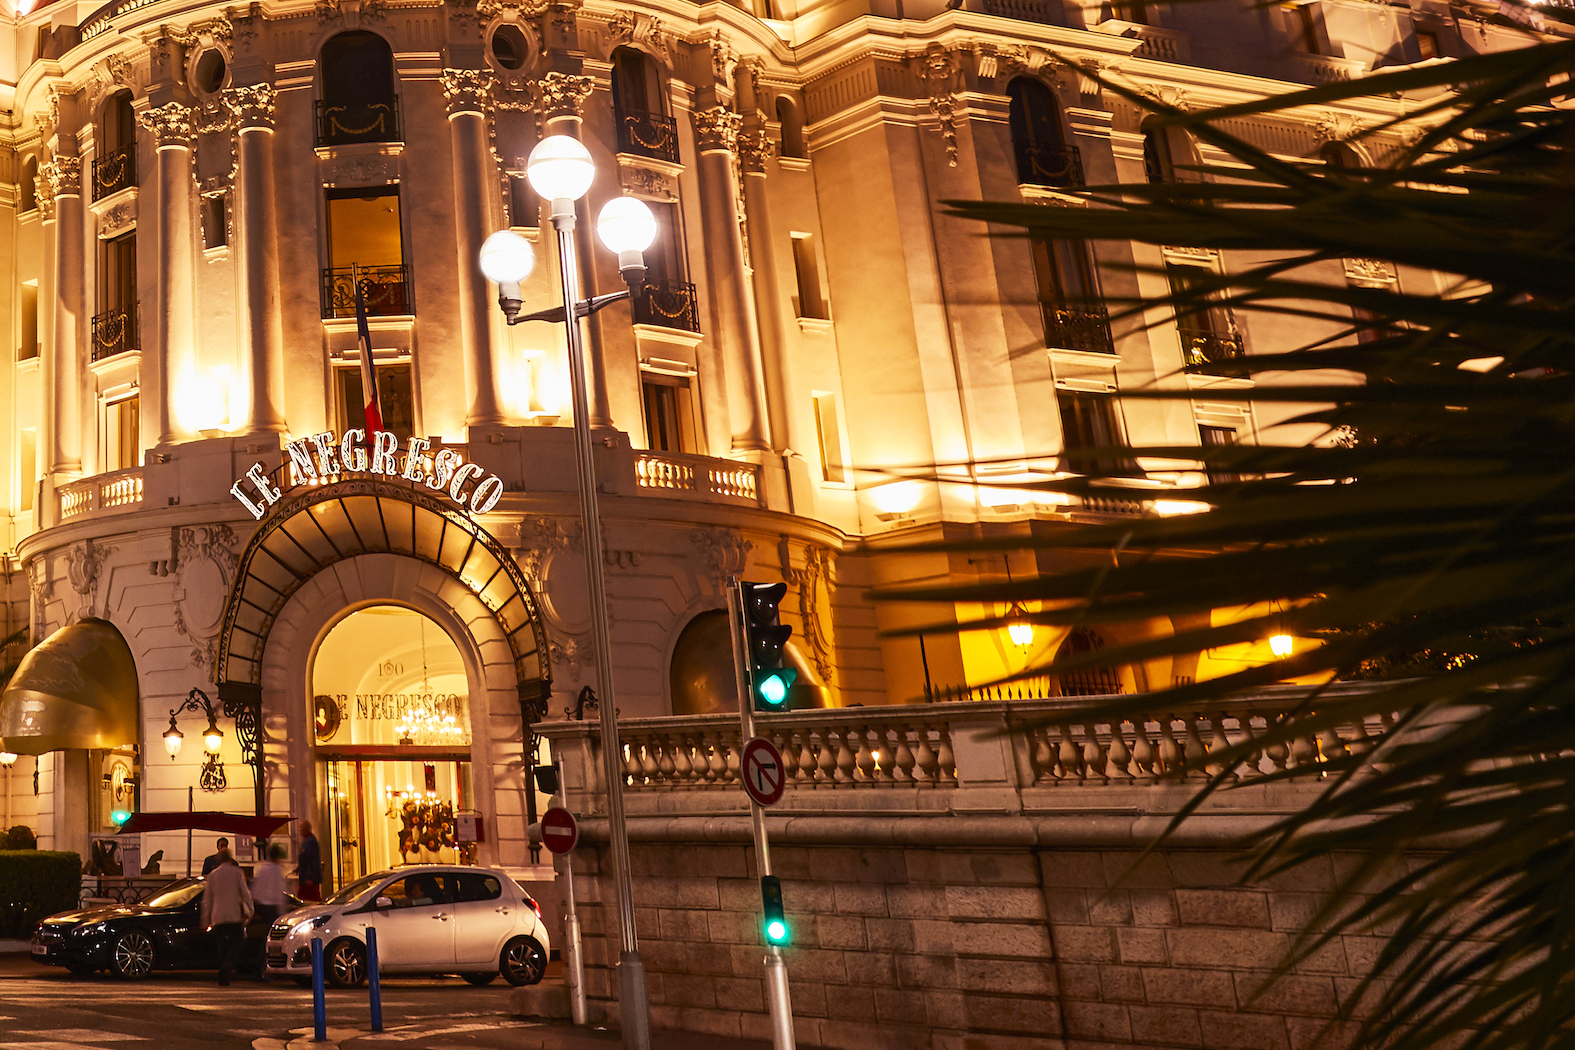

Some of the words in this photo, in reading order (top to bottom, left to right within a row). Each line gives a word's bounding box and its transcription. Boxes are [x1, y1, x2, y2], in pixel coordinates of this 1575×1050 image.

[230, 463, 282, 520] LE
[284, 428, 504, 515] NEGRESCO
[356, 693, 461, 720] NEGRESCO
